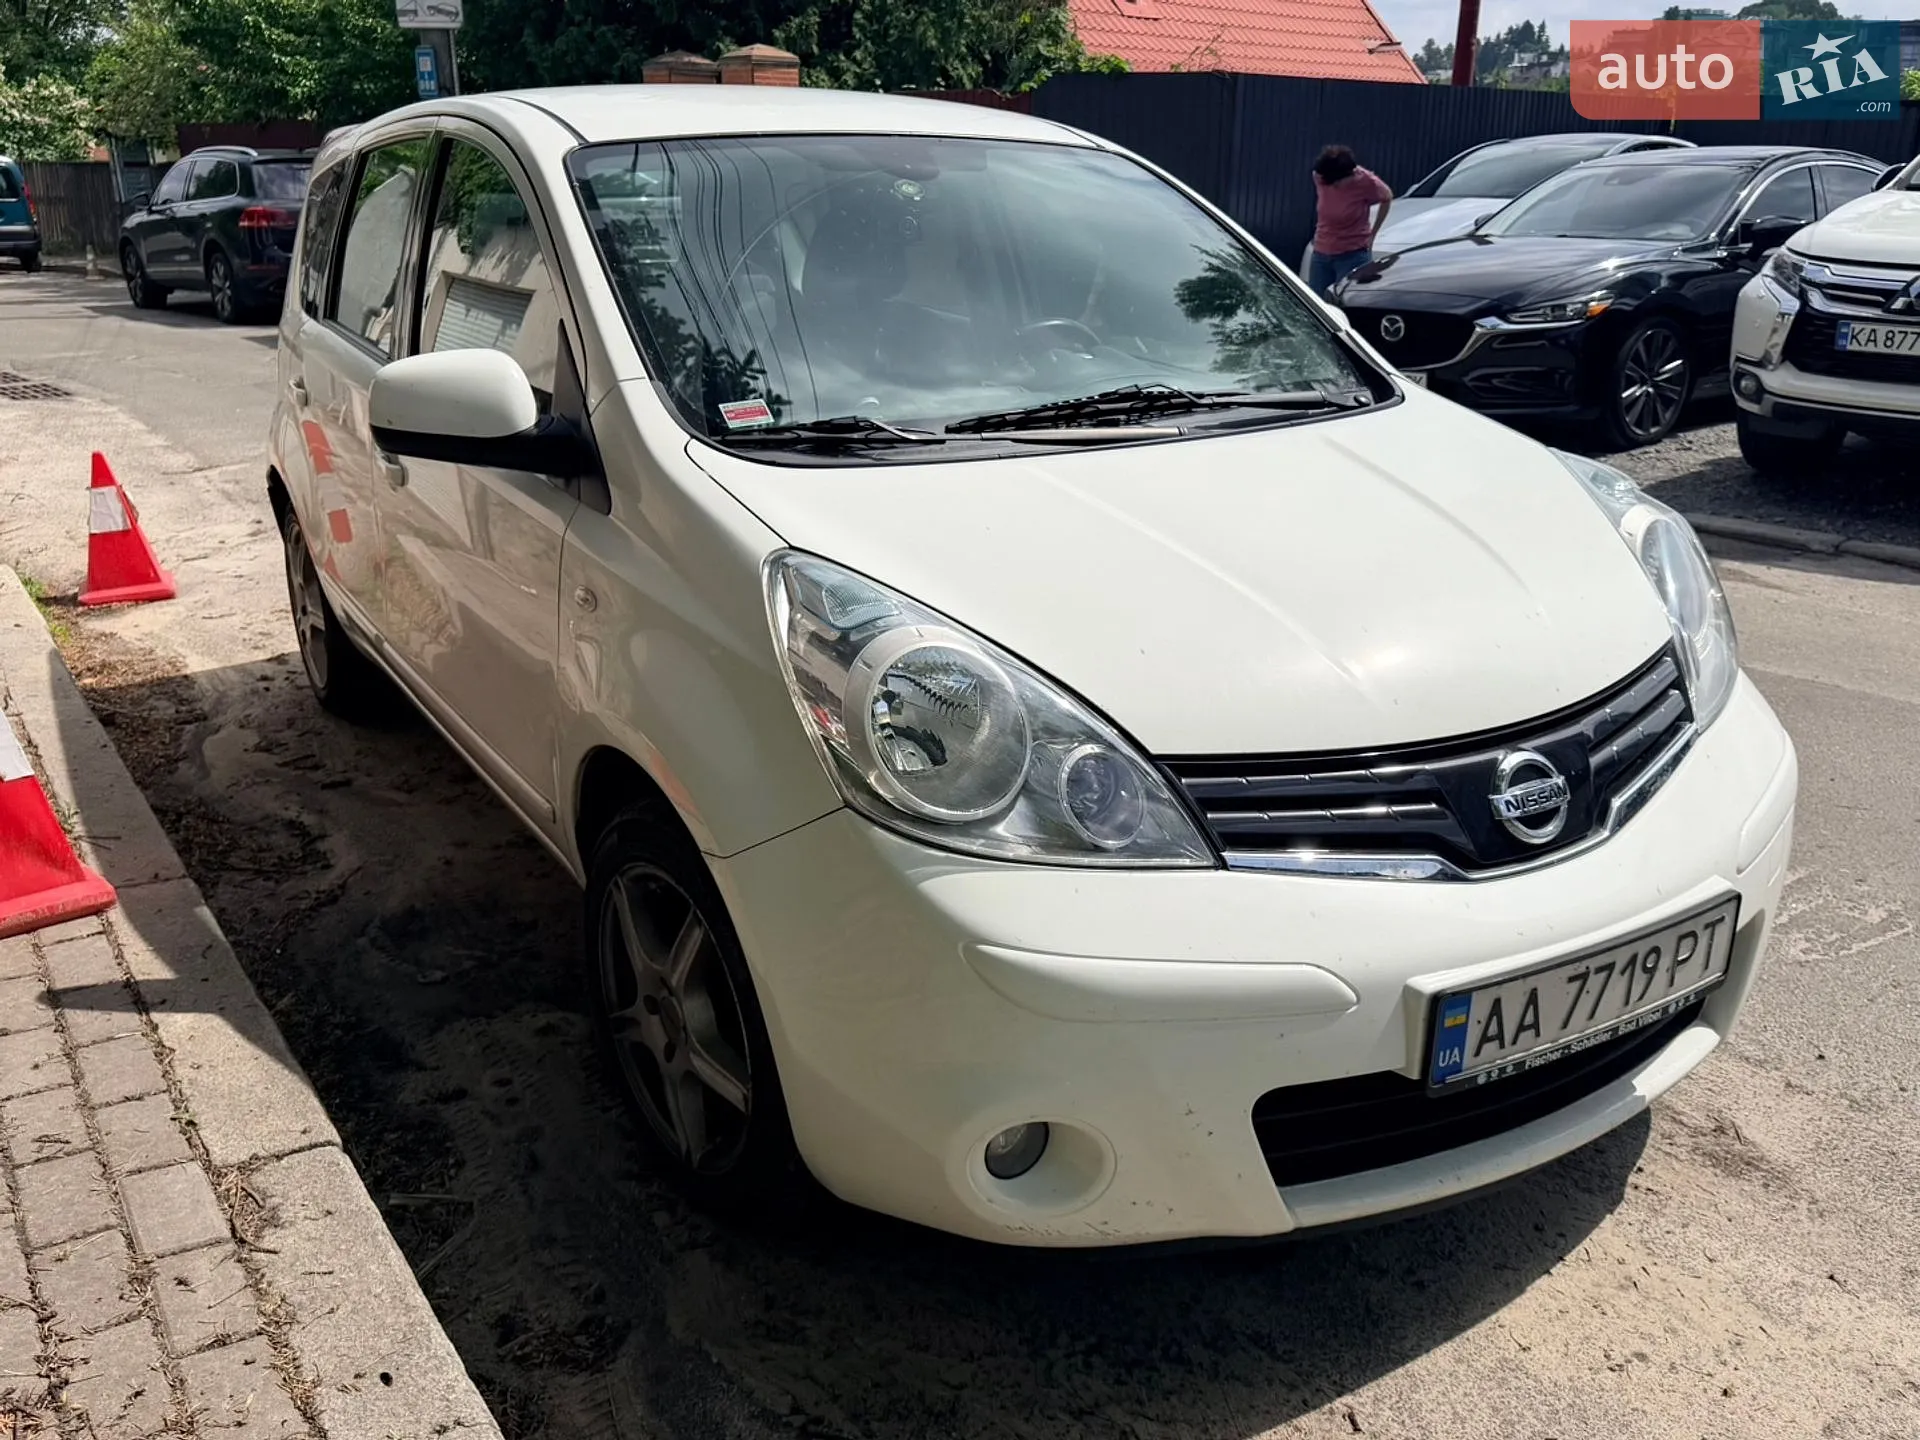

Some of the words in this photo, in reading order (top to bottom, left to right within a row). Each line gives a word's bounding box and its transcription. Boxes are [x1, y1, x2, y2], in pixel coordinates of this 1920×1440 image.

[1850, 327, 1878, 348] KA
[1505, 783, 1568, 812] NISSAN
[1473, 987, 1541, 1057] AA
[1561, 945, 1662, 1031] 7719
[1669, 915, 1726, 987] PT
[1438, 1052, 1462, 1067] UA
